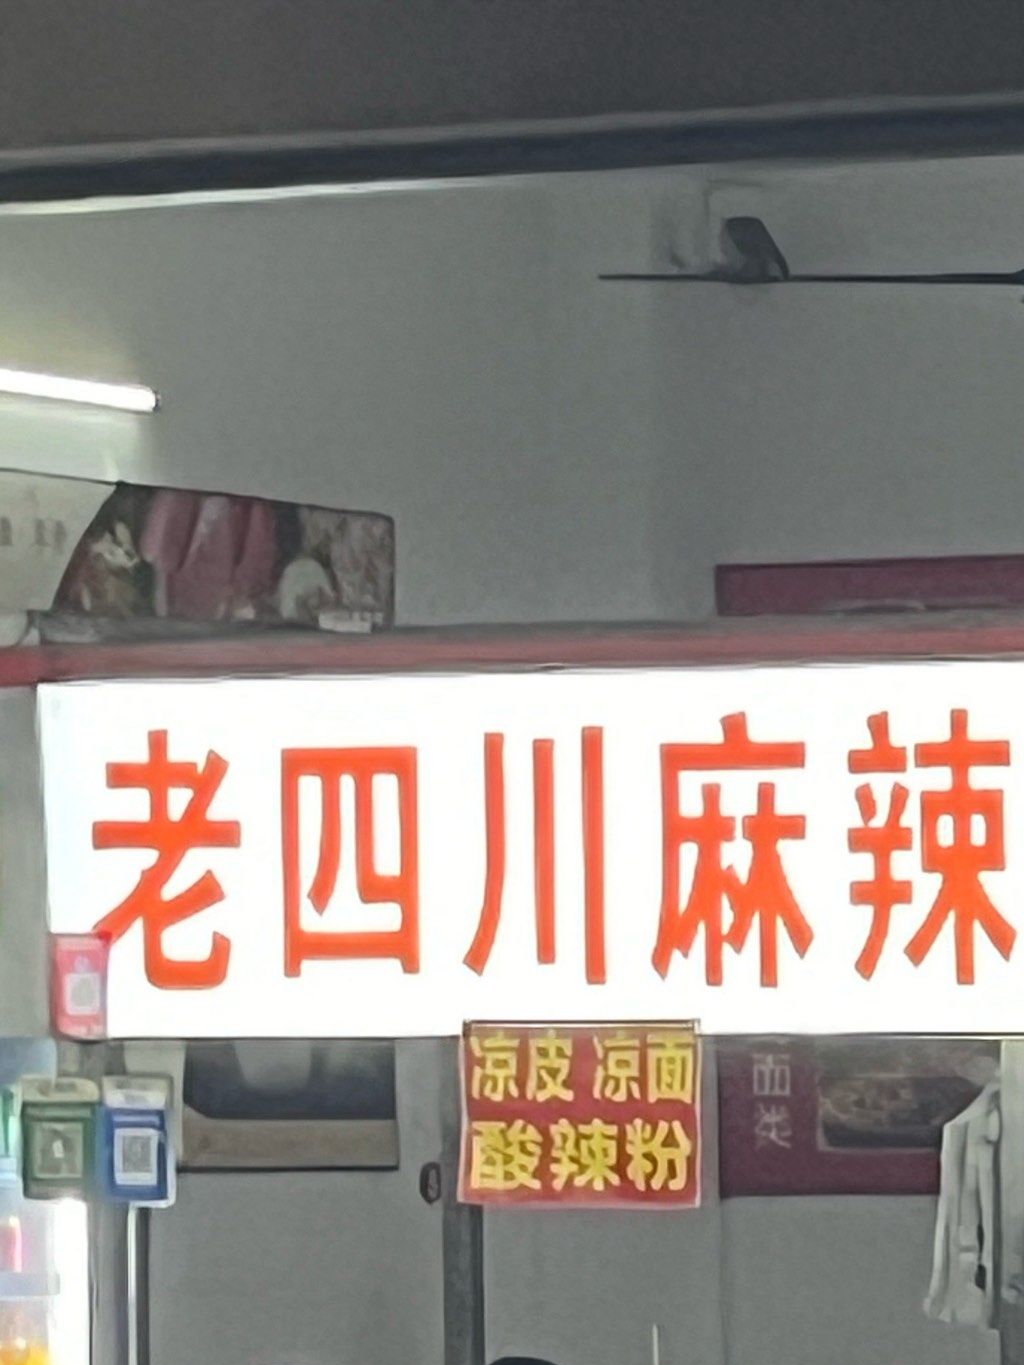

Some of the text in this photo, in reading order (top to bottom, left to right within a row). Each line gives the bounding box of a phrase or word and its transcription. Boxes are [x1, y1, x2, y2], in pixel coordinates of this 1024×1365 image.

[470, 1030, 694, 1104] 凉皮 凉面
[470, 1118, 692, 1191] 酸辣粉
